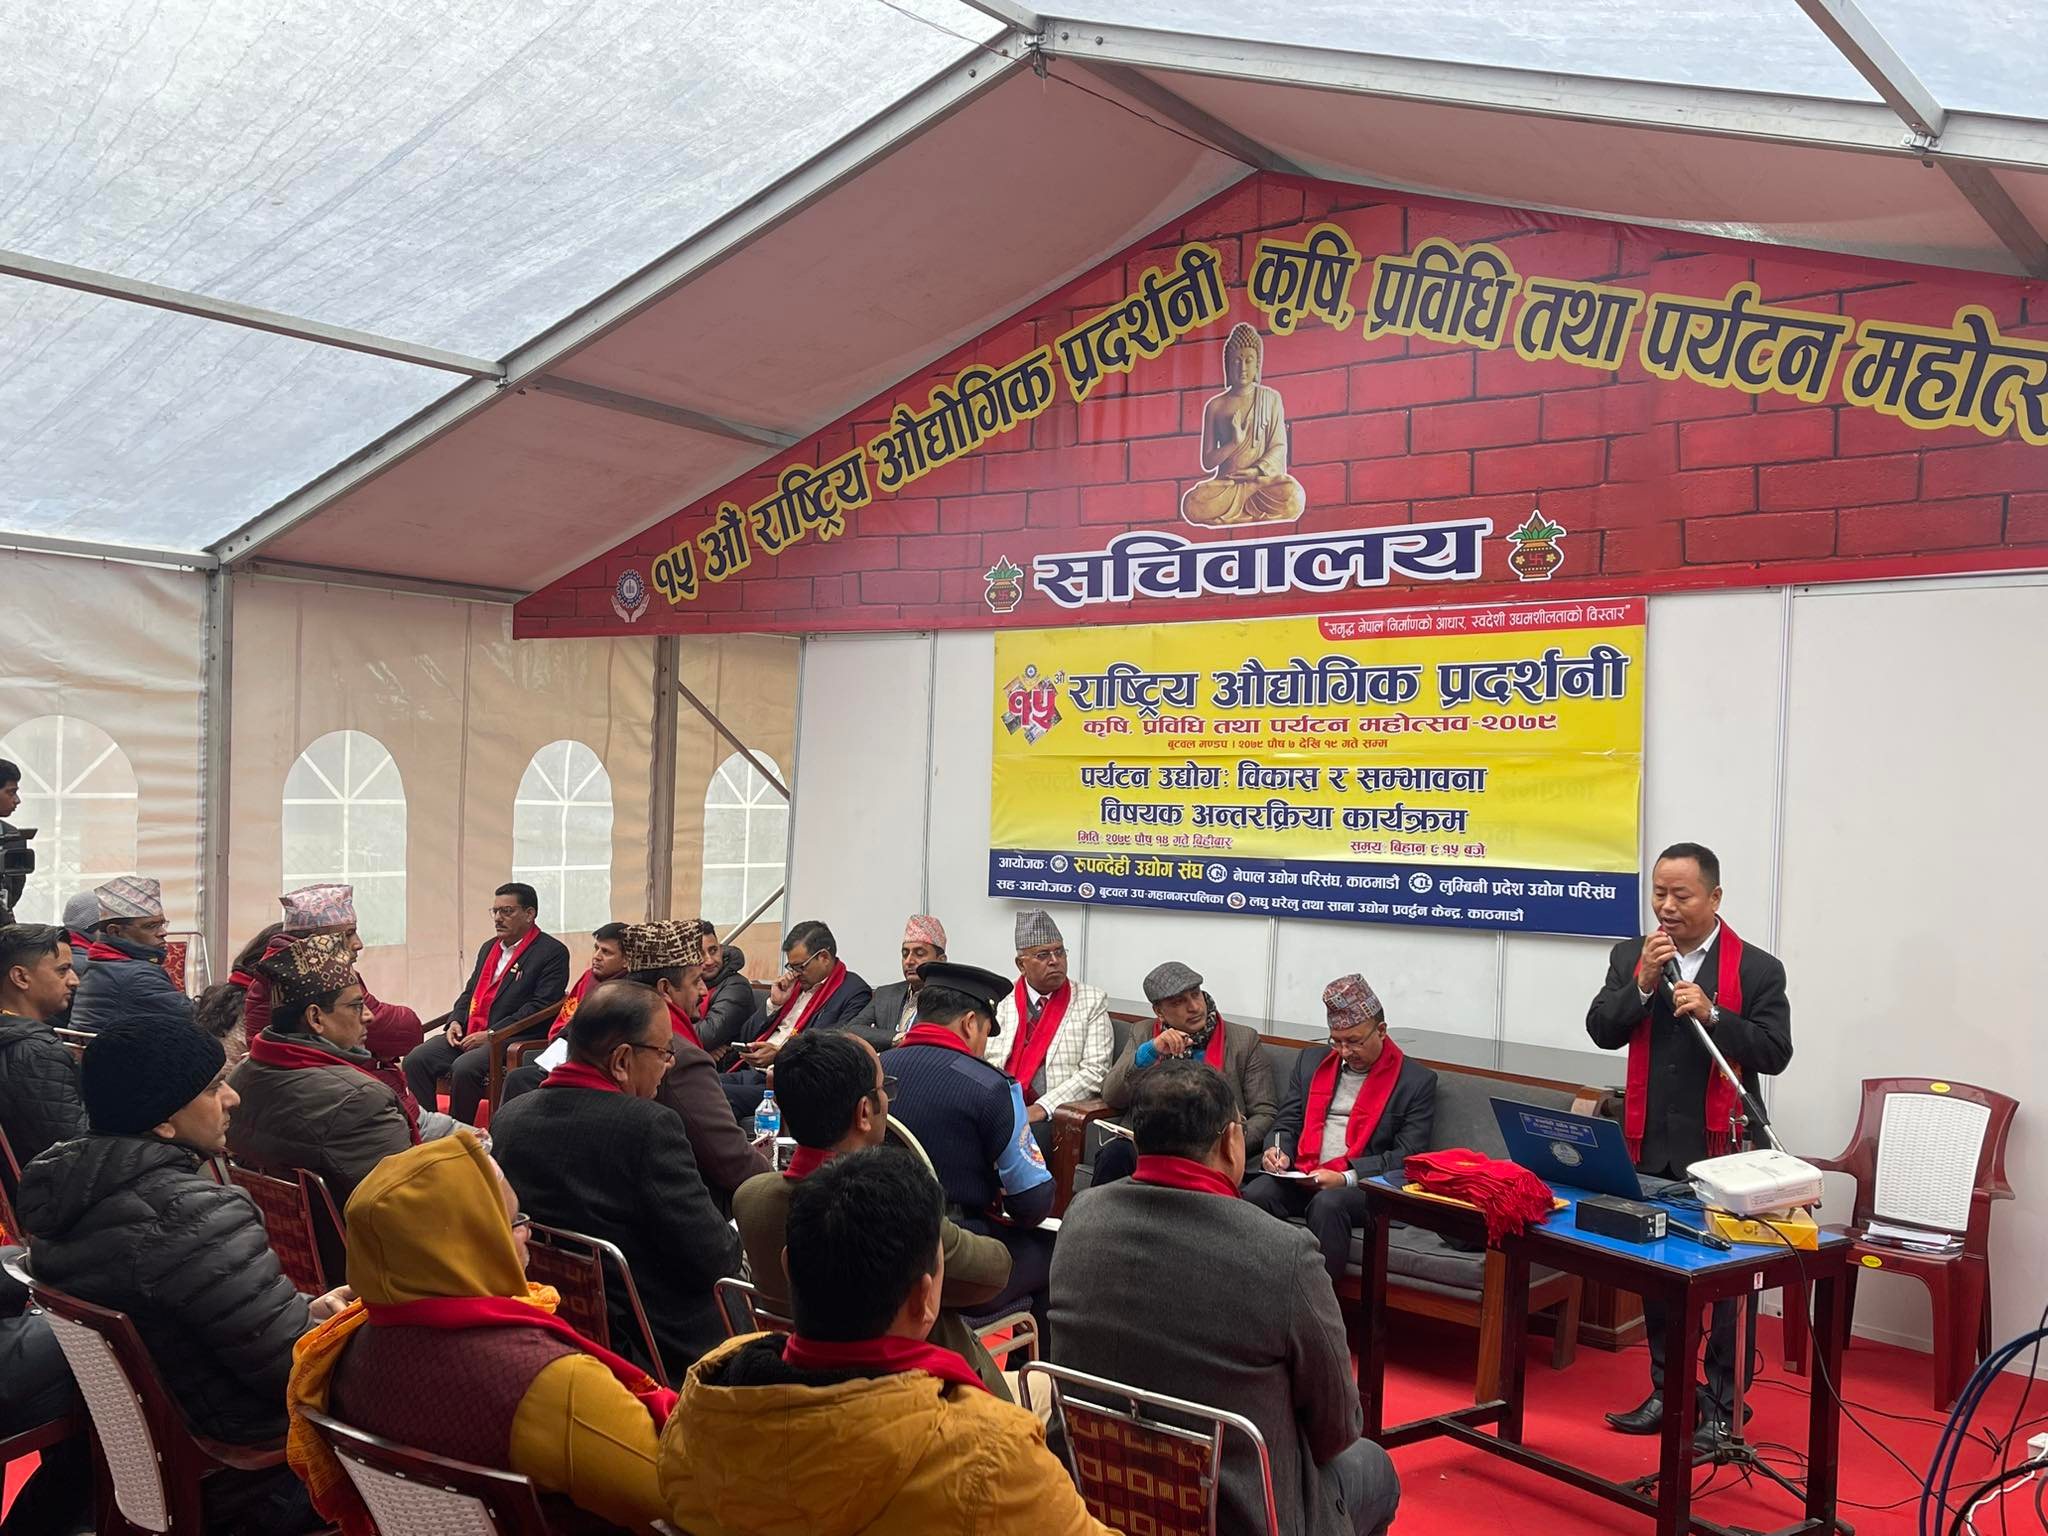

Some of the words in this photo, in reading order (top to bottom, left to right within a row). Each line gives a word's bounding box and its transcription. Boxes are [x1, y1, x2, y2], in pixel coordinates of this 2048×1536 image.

[654, 546, 696, 600] १५
[751, 452, 869, 550] राष्ट्रिय
[872, 351, 1051, 486] औद्योगिक
[1059, 248, 1224, 396] प्रदर्शनी
[1368, 244, 1516, 344] प्रविधि
[1519, 284, 1639, 363] तथा
[1646, 289, 1846, 395] पर्यटन
[1037, 523, 1488, 604] सचिवालय
[1358, 617, 1383, 634] नेपाल
[1386, 614, 1432, 634] निर्माणको
[1471, 609, 1505, 628] स्वदेशी
[1007, 688, 1056, 732] १५
[1068, 661, 1199, 718] राष्ट्रिय
[1212, 654, 1422, 709] औद्योगिक
[1437, 644, 1630, 709] प्रदर्शनी
[1143, 715, 1205, 736] प्रविधि
[1213, 717, 1261, 734] तथा
[1269, 714, 1350, 734] पर्यटन
[1167, 739, 1195, 751] बुटवल
[1238, 739, 1263, 749] २०७९
[1267, 737, 1285, 749] पौष
[1288, 739, 1295, 749] ७
[1299, 737, 1320, 749] देखि
[1324, 739, 1338, 749] १९
[1341, 737, 1358, 749] गते
[1362, 739, 1388, 749] सम्म
[1081, 761, 1151, 789] पर्यटन
[1237, 759, 1320, 791] विकास
[1328, 767, 1349, 791] र
[1356, 767, 1488, 793] सम्भावना
[1100, 796, 1184, 825] विषयक
[1191, 798, 1334, 830] अन्तरक्रिया
[1342, 802, 1469, 833] कार्यक्रम
[1389, 839, 1426, 855] बिहान
[1463, 841, 1486, 857] बजे
[1134, 856, 1174, 878] उद्योग
[1177, 859, 1205, 881] संघ
[1233, 866, 1264, 884] नेपाल
[1267, 868, 1298, 886] उद्योग
[1438, 876, 1488, 898] लुम्बिनी
[1491, 878, 1524, 897] प्रदेश
[1528, 879, 1564, 898] उद्योग
[1568, 881, 1617, 901] परिसंघ
[1099, 886, 1128, 900] बुटवल
[1248, 895, 1270, 911] लघु
[1302, 899, 1324, 911] तथा
[1327, 900, 1354, 913] साना
[1358, 900, 1389, 915] उद्योग
